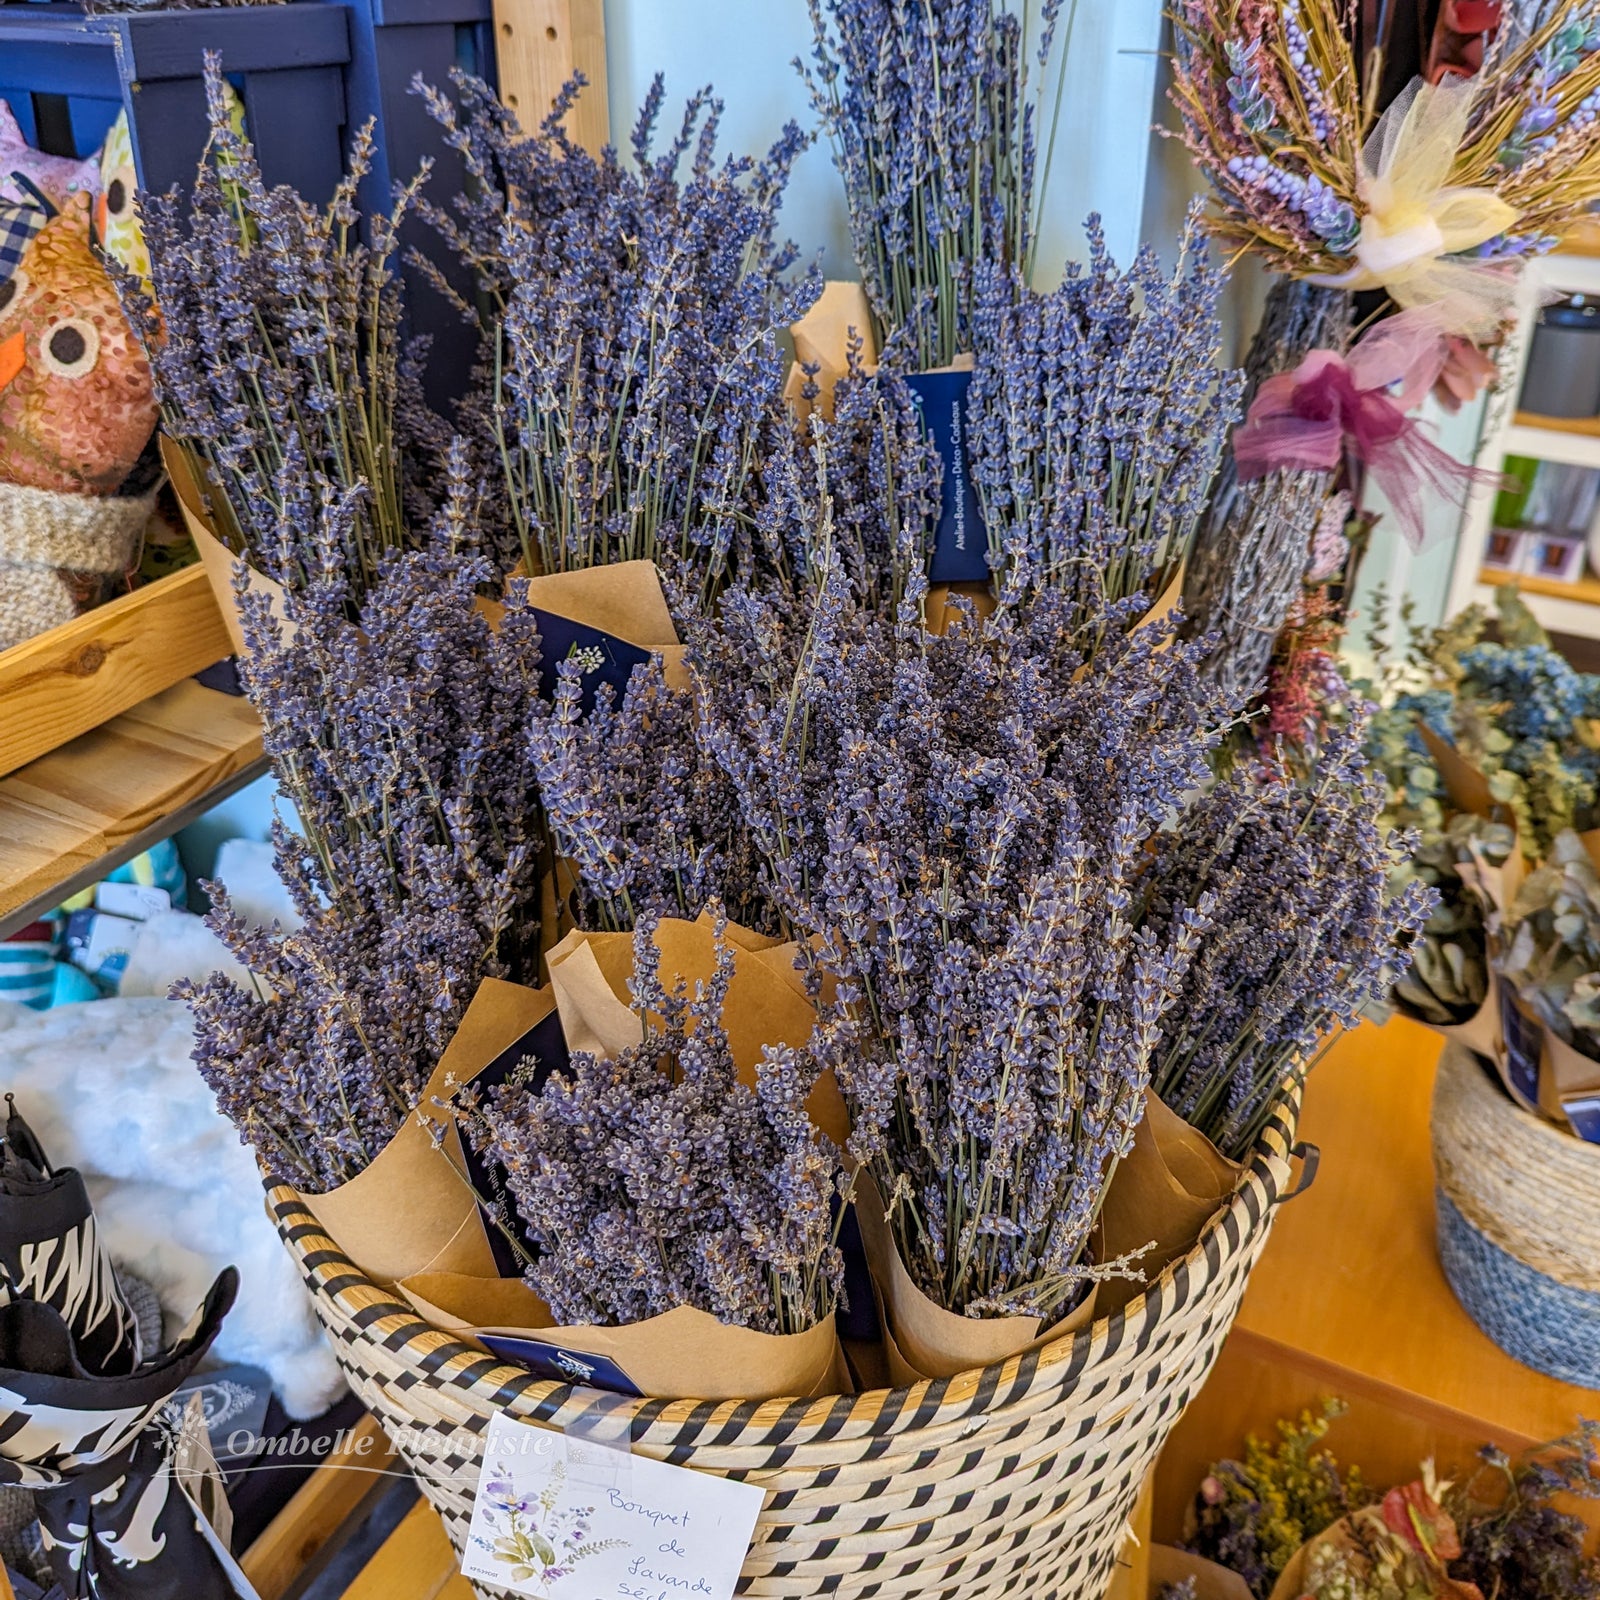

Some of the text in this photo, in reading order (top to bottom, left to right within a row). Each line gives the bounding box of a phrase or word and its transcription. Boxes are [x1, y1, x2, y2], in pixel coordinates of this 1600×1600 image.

[949, 400, 961, 445] Cadeaux
[952, 449, 962, 474] Déco
[606, 1488, 690, 1527] Bouquet
[658, 1539, 686, 1558] de
[627, 1556, 713, 1595] Lavande
